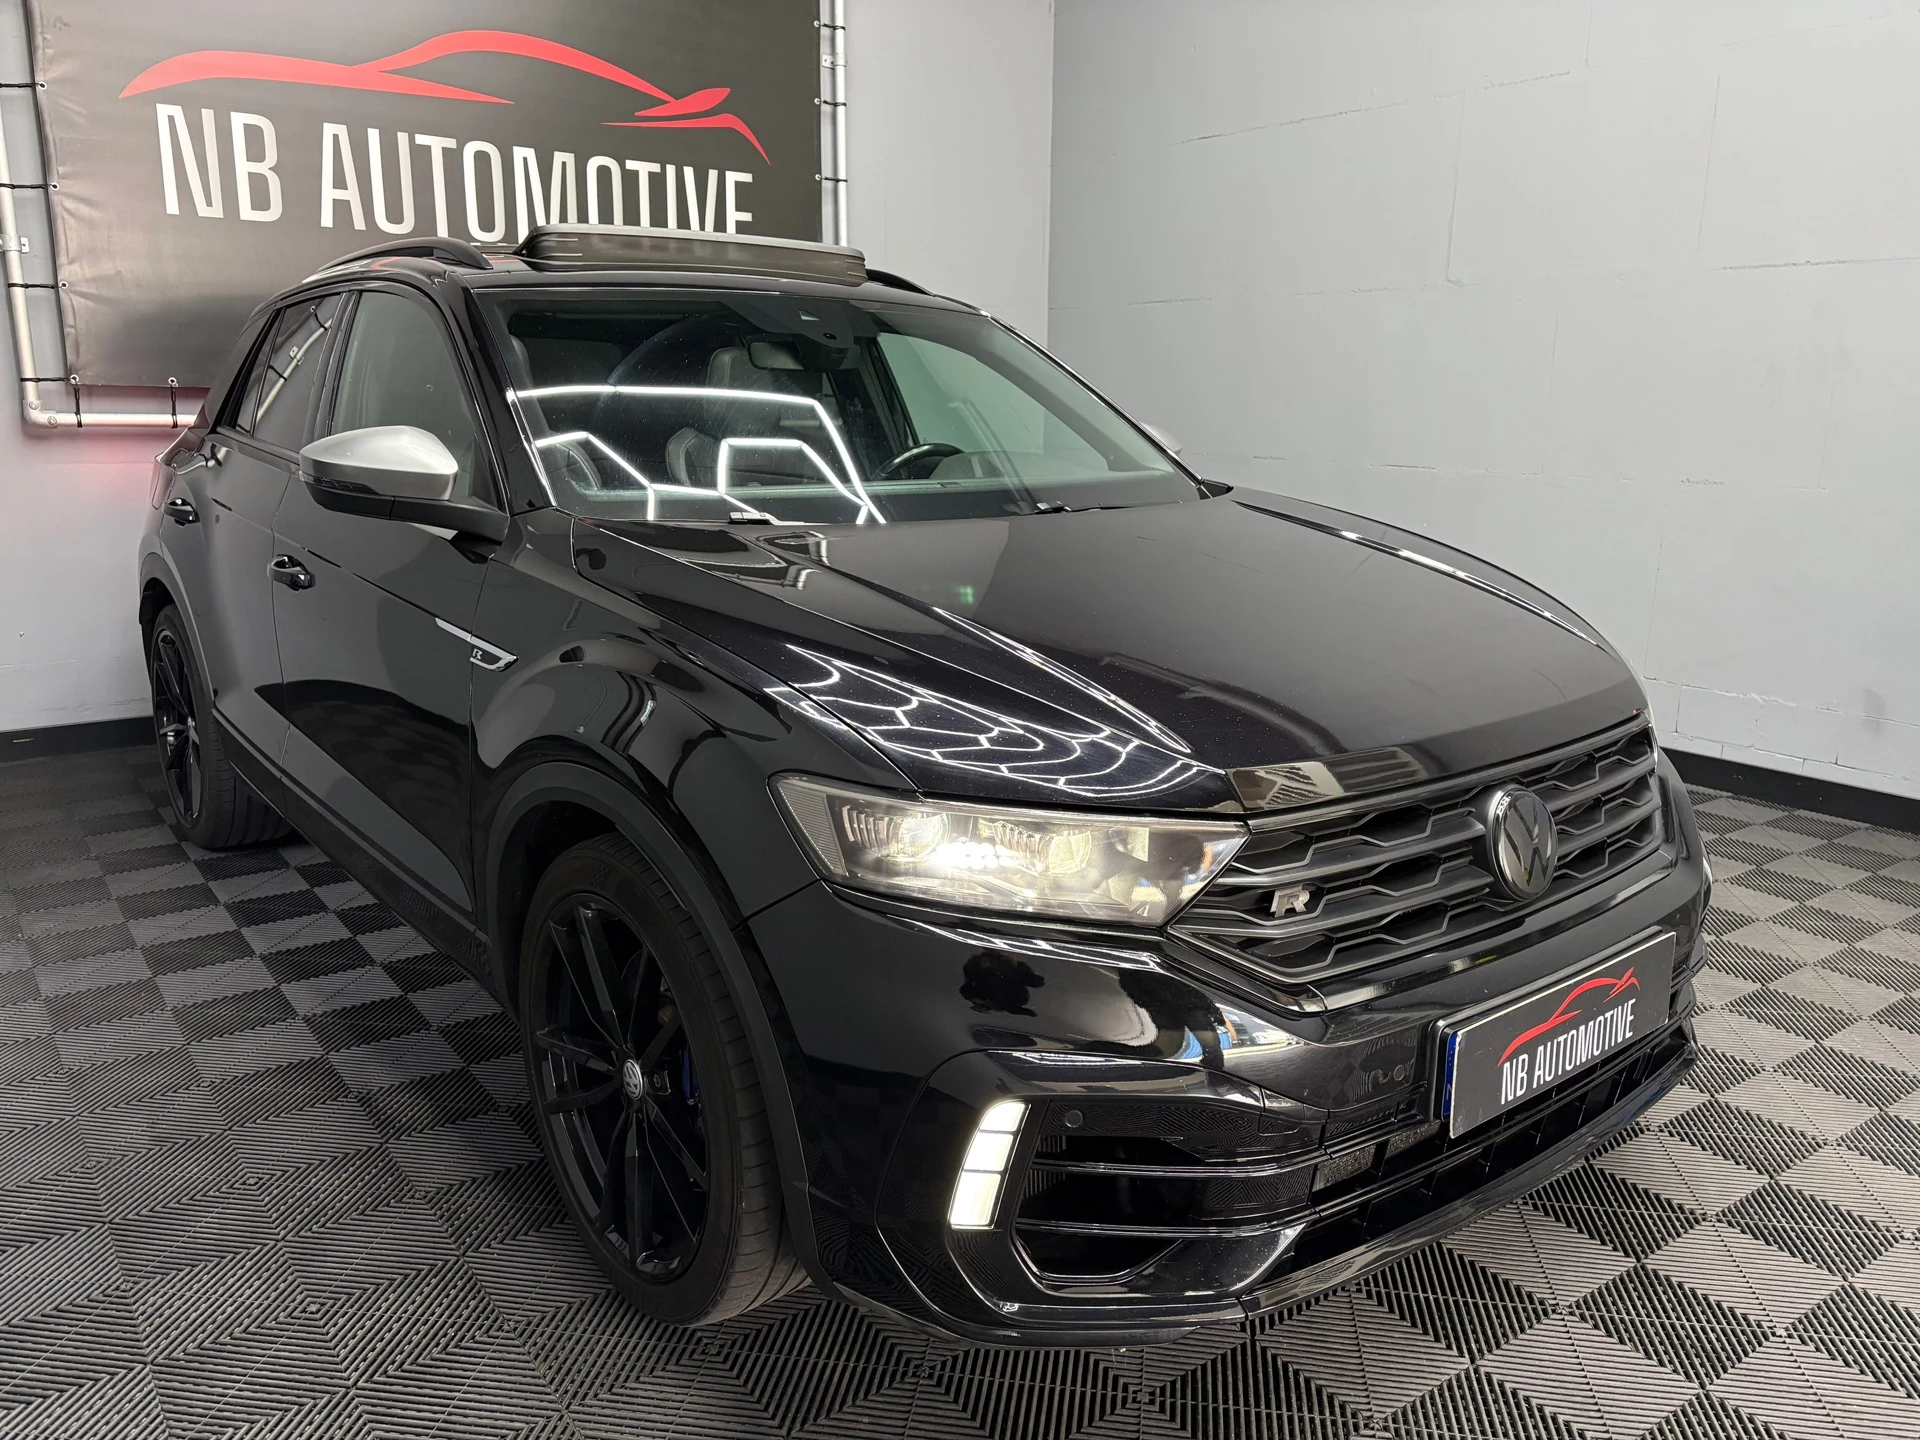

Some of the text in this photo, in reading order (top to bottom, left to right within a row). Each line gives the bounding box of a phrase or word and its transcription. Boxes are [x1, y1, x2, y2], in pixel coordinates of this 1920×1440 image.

[155, 103, 753, 245] NB AUTOMOTIVE
[472, 648, 483, 660] R
[1270, 886, 1309, 918] R
[1501, 998, 1636, 1105] NB AUTOMOTIVE
